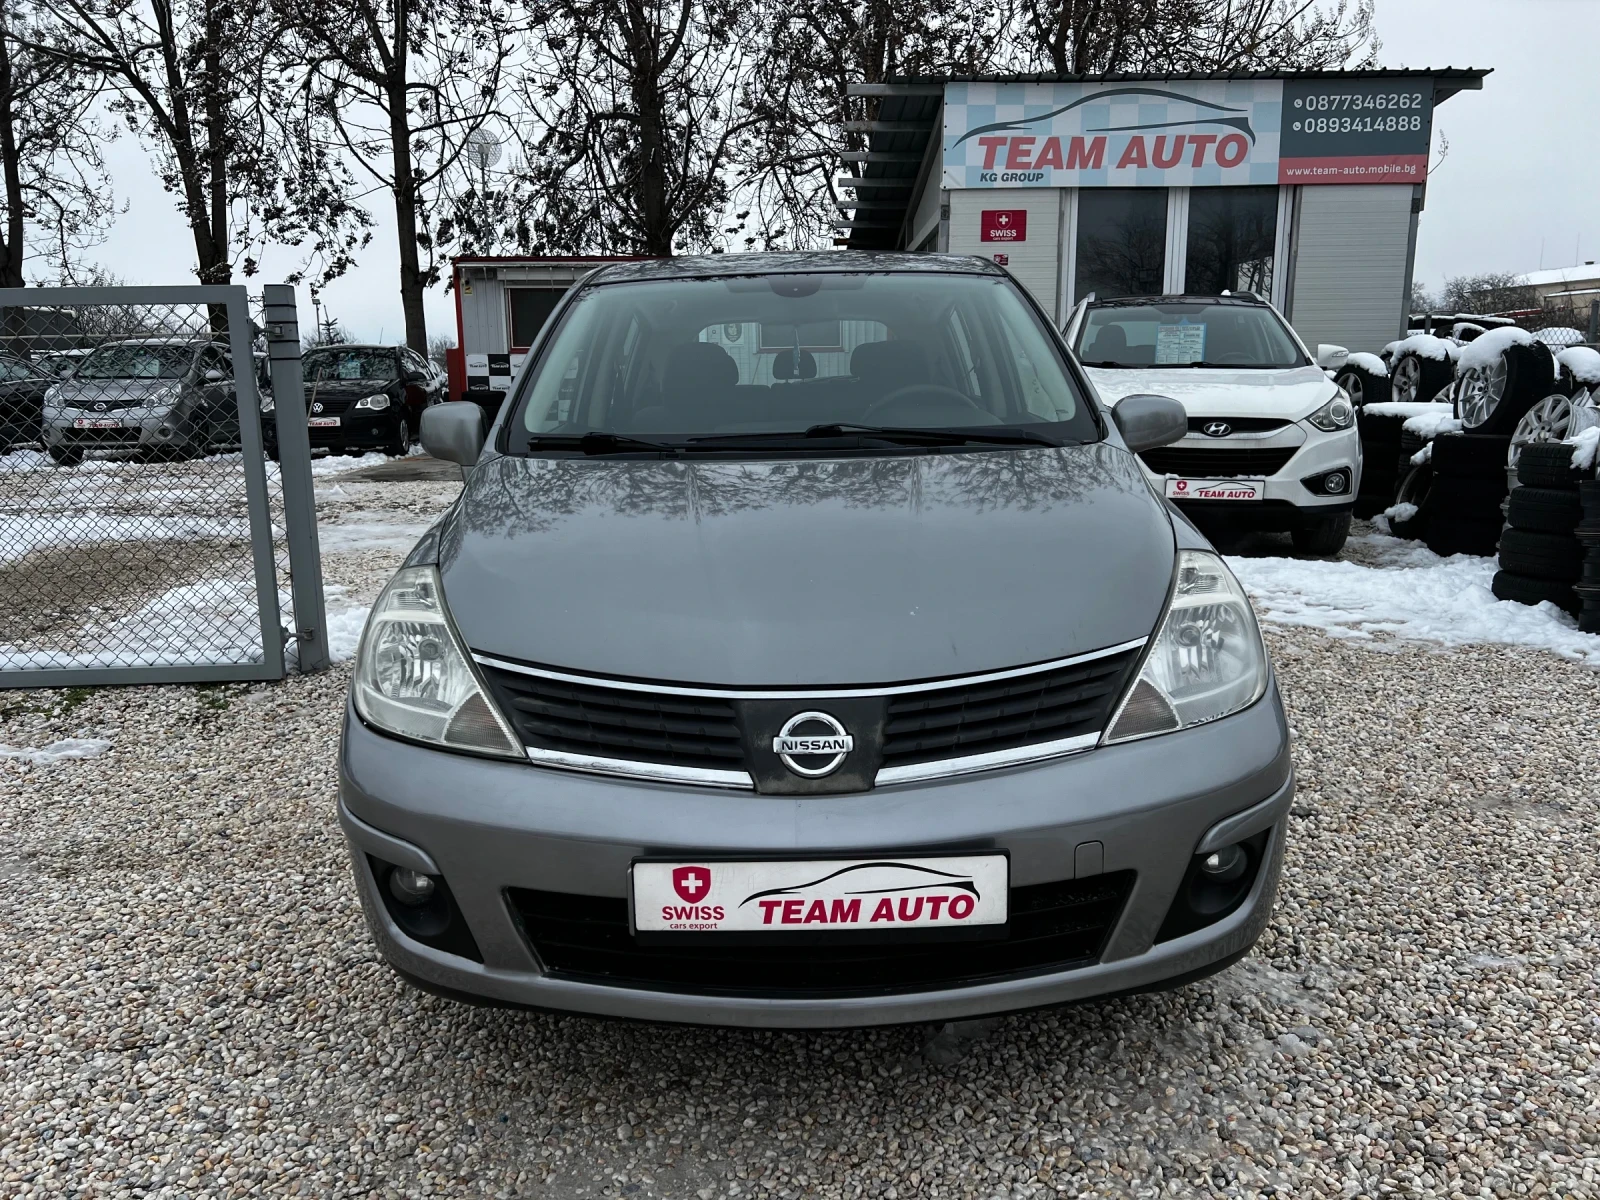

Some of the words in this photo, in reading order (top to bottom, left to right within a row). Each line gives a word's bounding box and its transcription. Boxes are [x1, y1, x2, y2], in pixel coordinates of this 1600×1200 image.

[1306, 94, 1422, 110] 0877346262
[1304, 116, 1421, 133] 0893414888
[978, 136, 1107, 170] TEAM
[1116, 133, 1249, 169] AUTO
[980, 172, 998, 182] KG
[1001, 172, 1044, 182] GROUP
[1286, 163, 1416, 176] www.team-auto.mobile.bg
[1199, 490, 1224, 498] TEAM
[1227, 490, 1255, 498] AUTO
[781, 738, 846, 752] NISSAN
[662, 905, 725, 921] SWISS
[758, 898, 862, 925] TEAM
[870, 894, 975, 923] AUTO
[670, 922, 687, 930] cars
[689, 922, 718, 931] export
